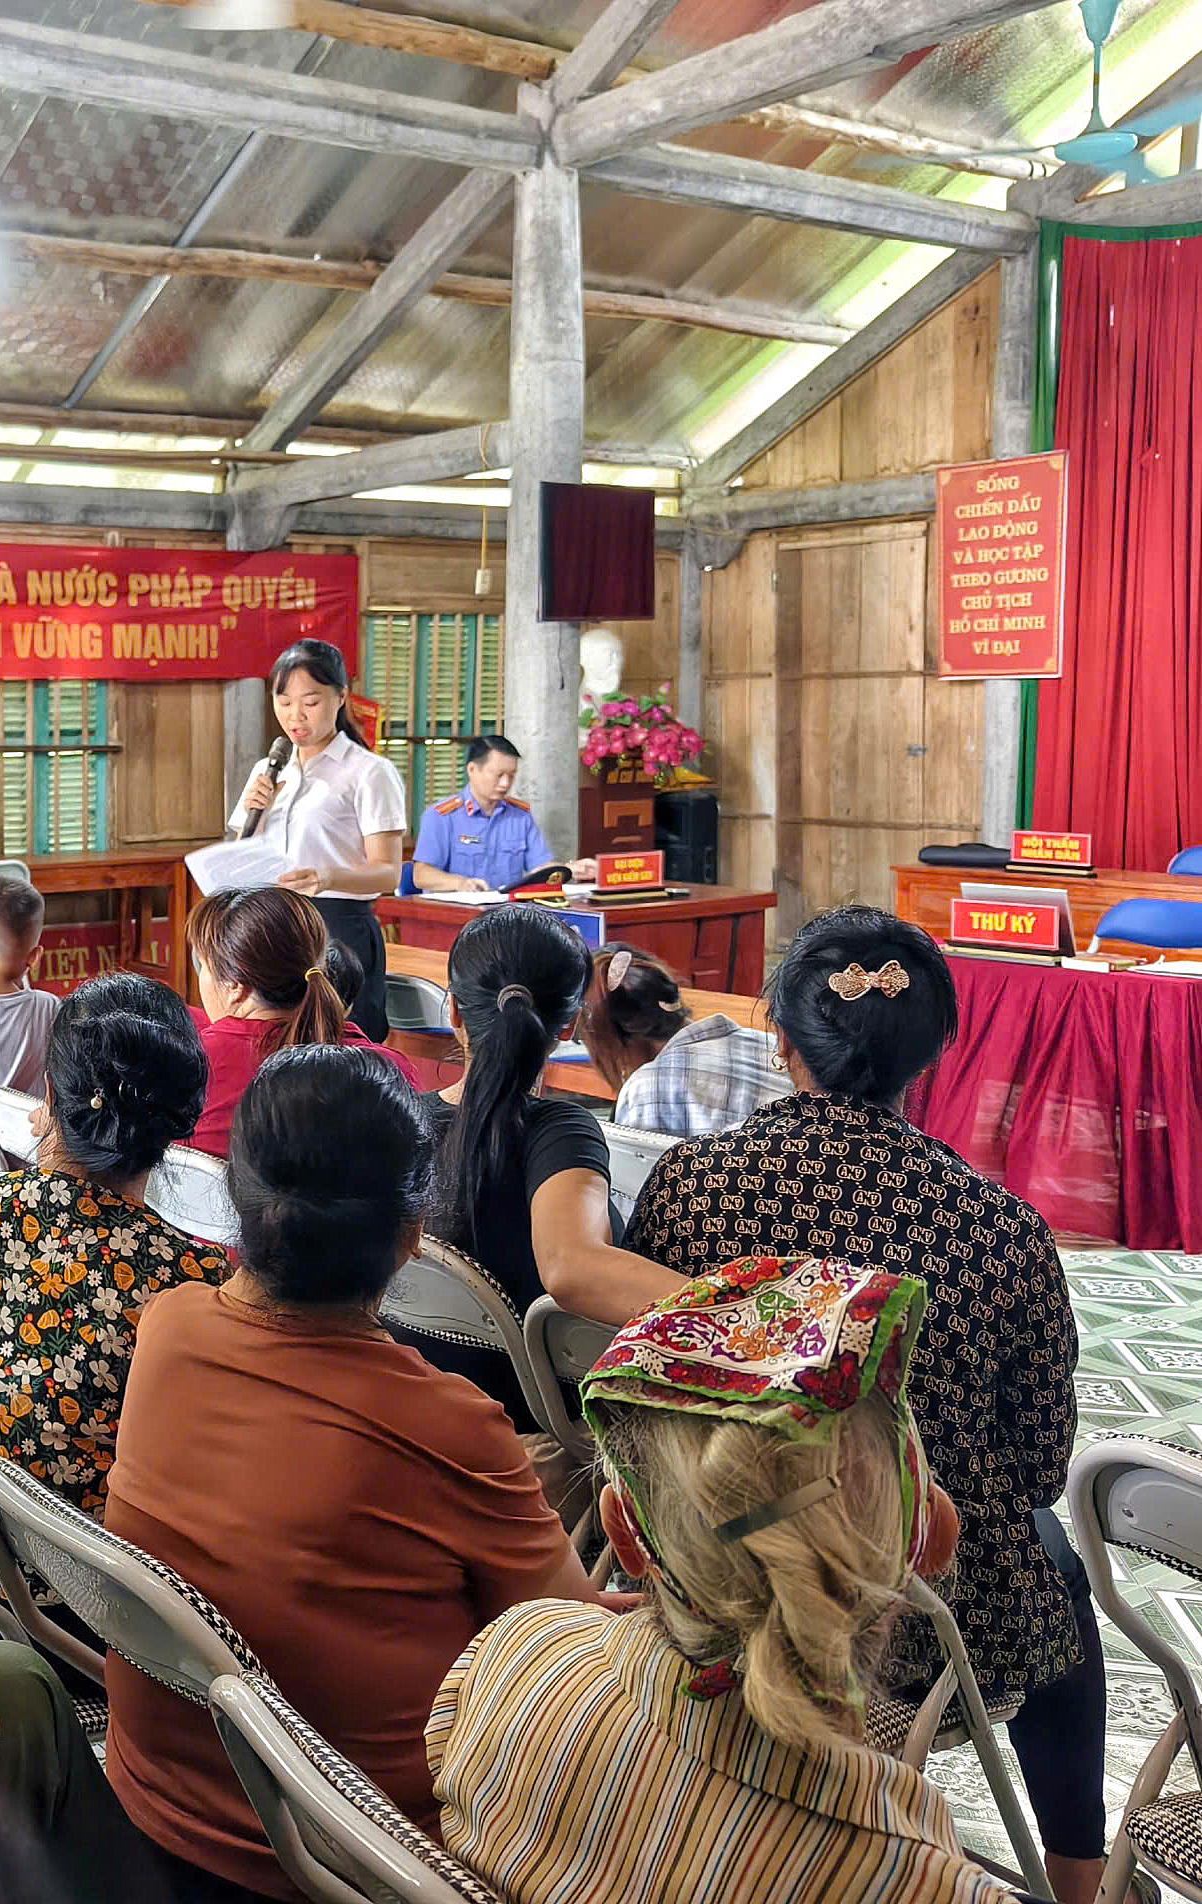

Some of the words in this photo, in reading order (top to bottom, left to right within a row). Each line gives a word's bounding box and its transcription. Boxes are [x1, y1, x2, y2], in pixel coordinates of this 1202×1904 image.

[977, 471, 1020, 494] SỐNG
[956, 496, 1003, 519] CHIẾN
[1007, 491, 1042, 514] ĐẤU
[958, 525, 990, 541] LAO
[993, 520, 1038, 540] ĐỘNG
[977, 547, 1010, 565] HỌC
[1011, 541, 1044, 563] TẬP
[26, 564, 118, 607] NƯỚC
[128, 566, 213, 608] PHÁP
[951, 571, 991, 588] THEO
[961, 590, 993, 610] CHỦ
[995, 592, 1033, 611] TỊCH
[973, 613, 1000, 633] CHÍ
[1003, 614, 1046, 632] MINH
[12, 615, 103, 659] VỮNG
[969, 911, 1008, 931] THƯ
[1010, 911, 1037, 934] KÝ
